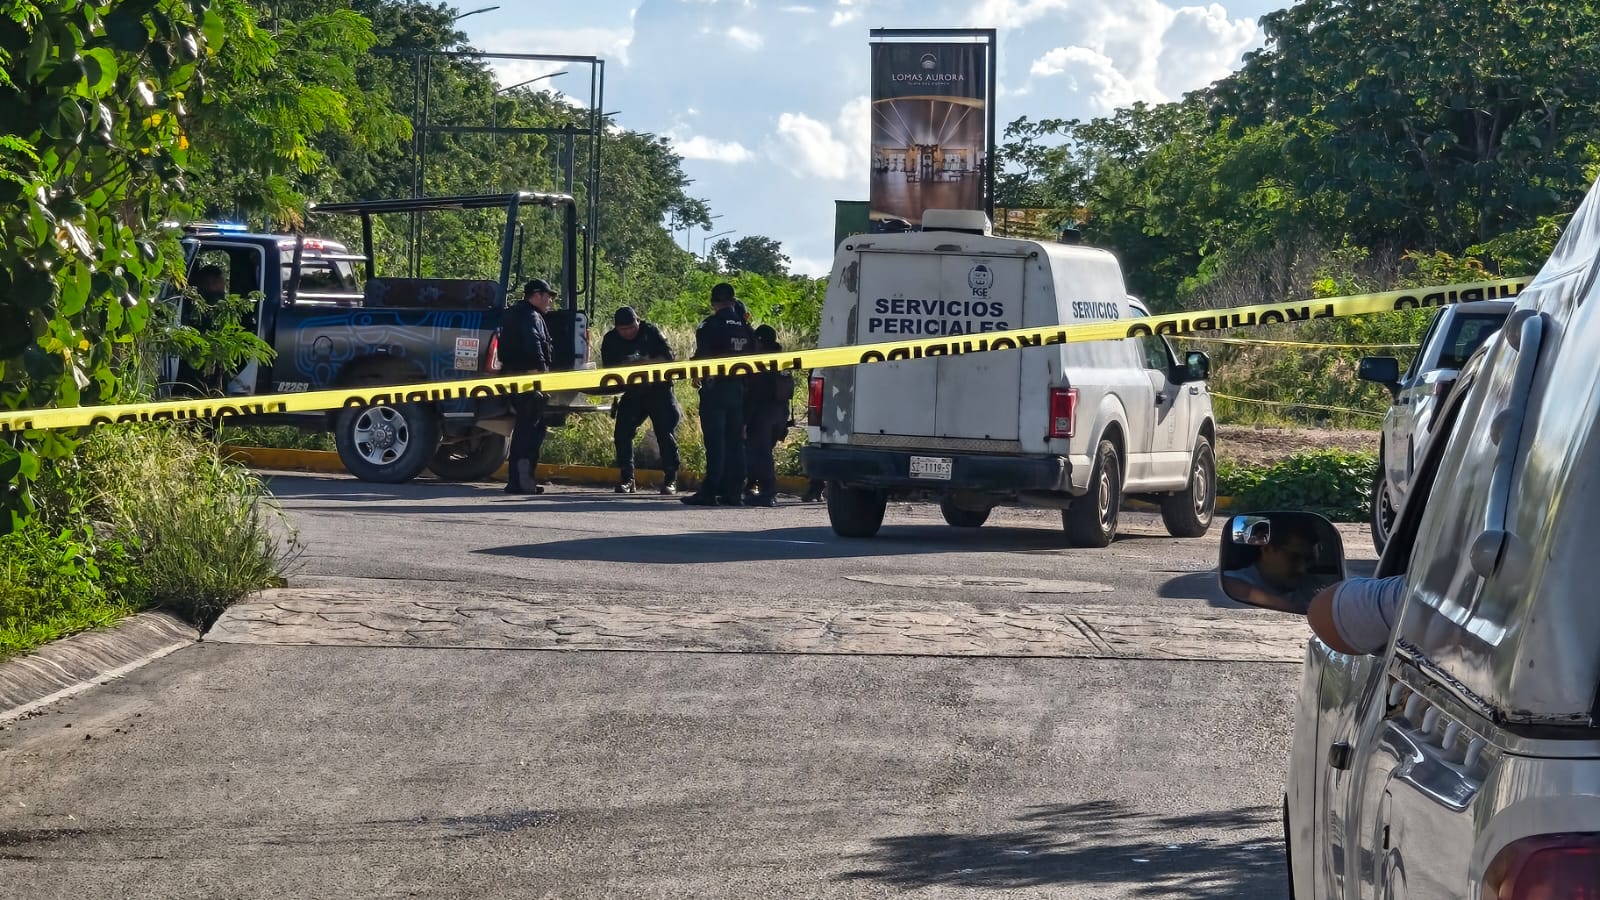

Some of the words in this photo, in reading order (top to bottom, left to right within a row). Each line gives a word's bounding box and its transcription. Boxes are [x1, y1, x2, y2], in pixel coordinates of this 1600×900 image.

[892, 73, 923, 81] LOMAS
[925, 73, 964, 81] AURORA
[875, 298, 1004, 317] SERVICIOS
[1072, 301, 1119, 320] SERVICIOS
